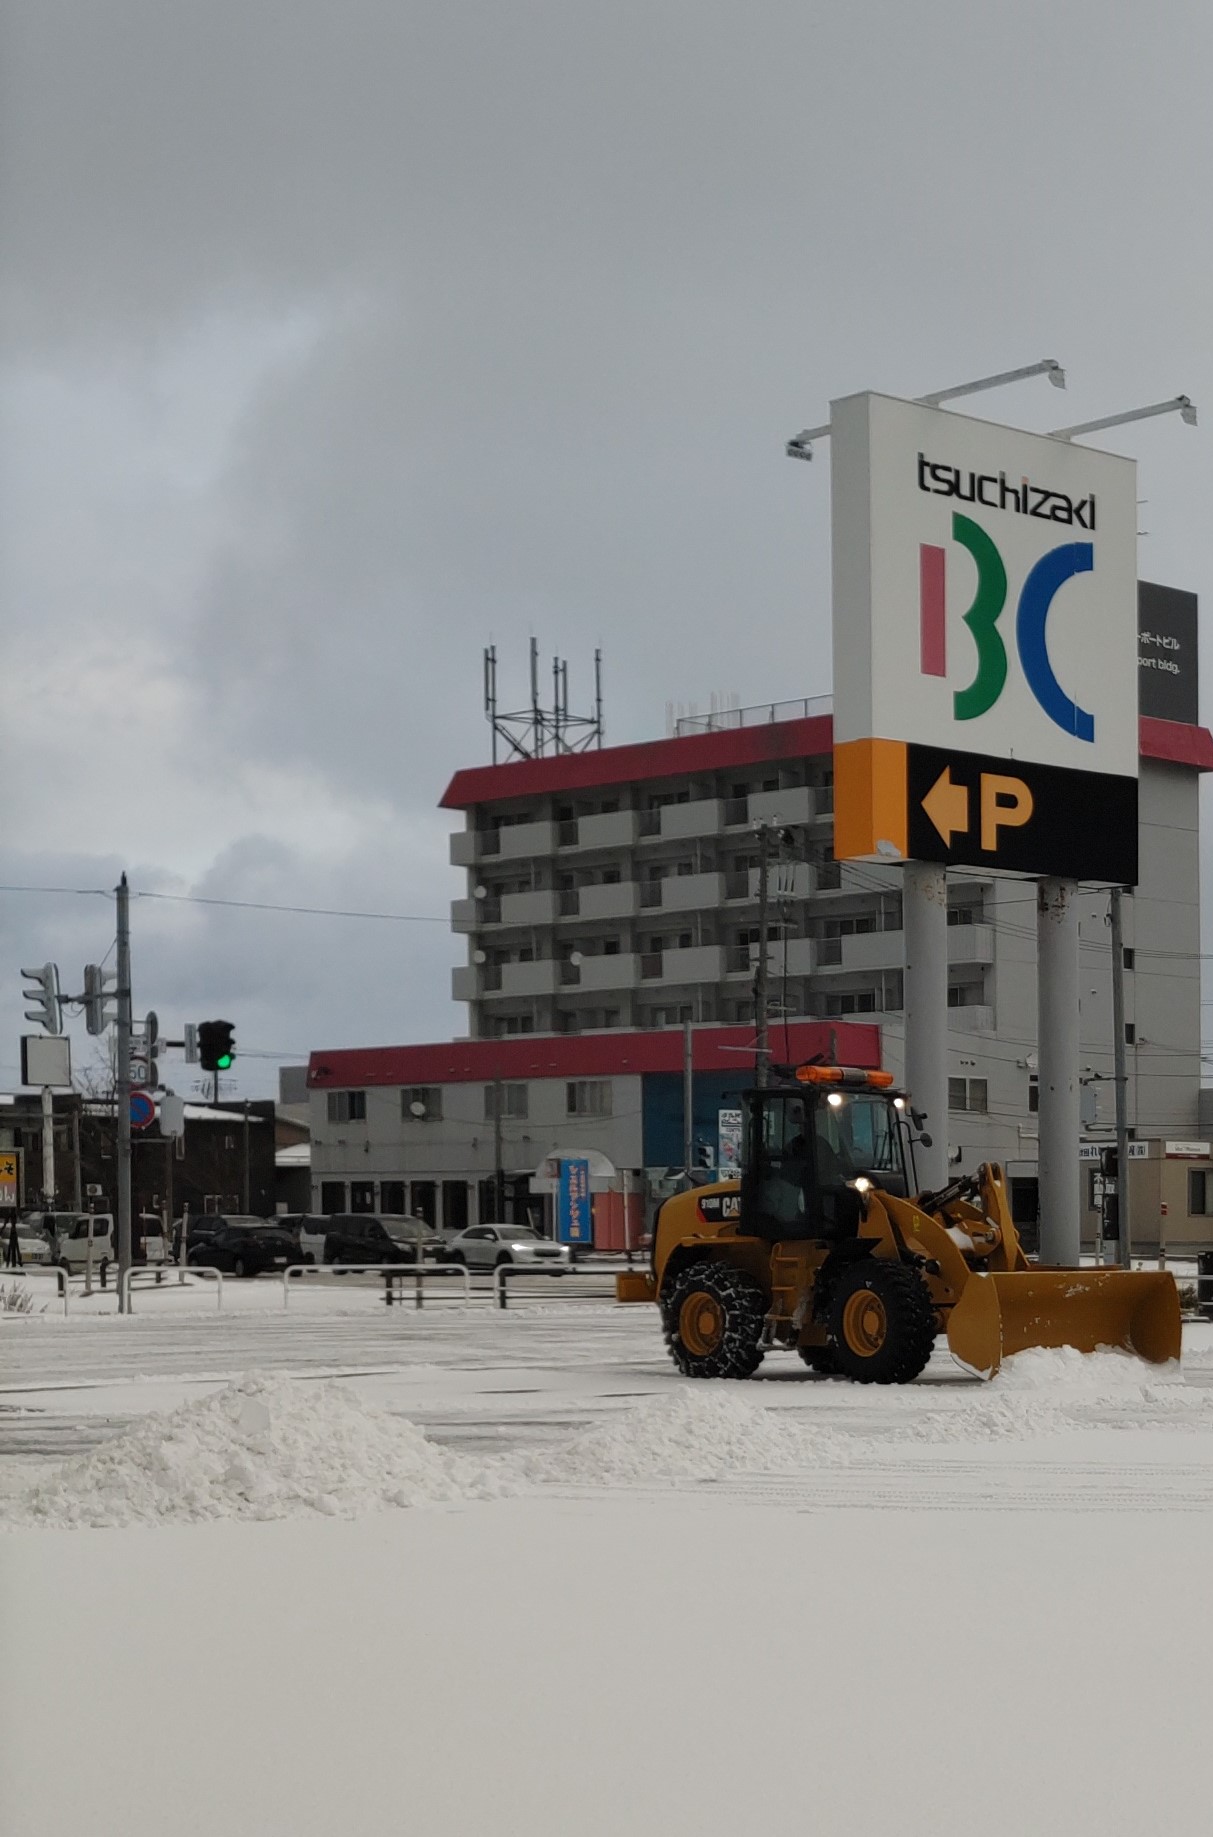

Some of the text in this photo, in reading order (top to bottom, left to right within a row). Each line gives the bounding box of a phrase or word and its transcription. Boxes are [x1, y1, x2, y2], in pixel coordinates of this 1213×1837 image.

[918, 451, 1096, 531] tsuchizaki
[1158, 658, 1181, 675] bldg.
[980, 773, 1034, 851] P
